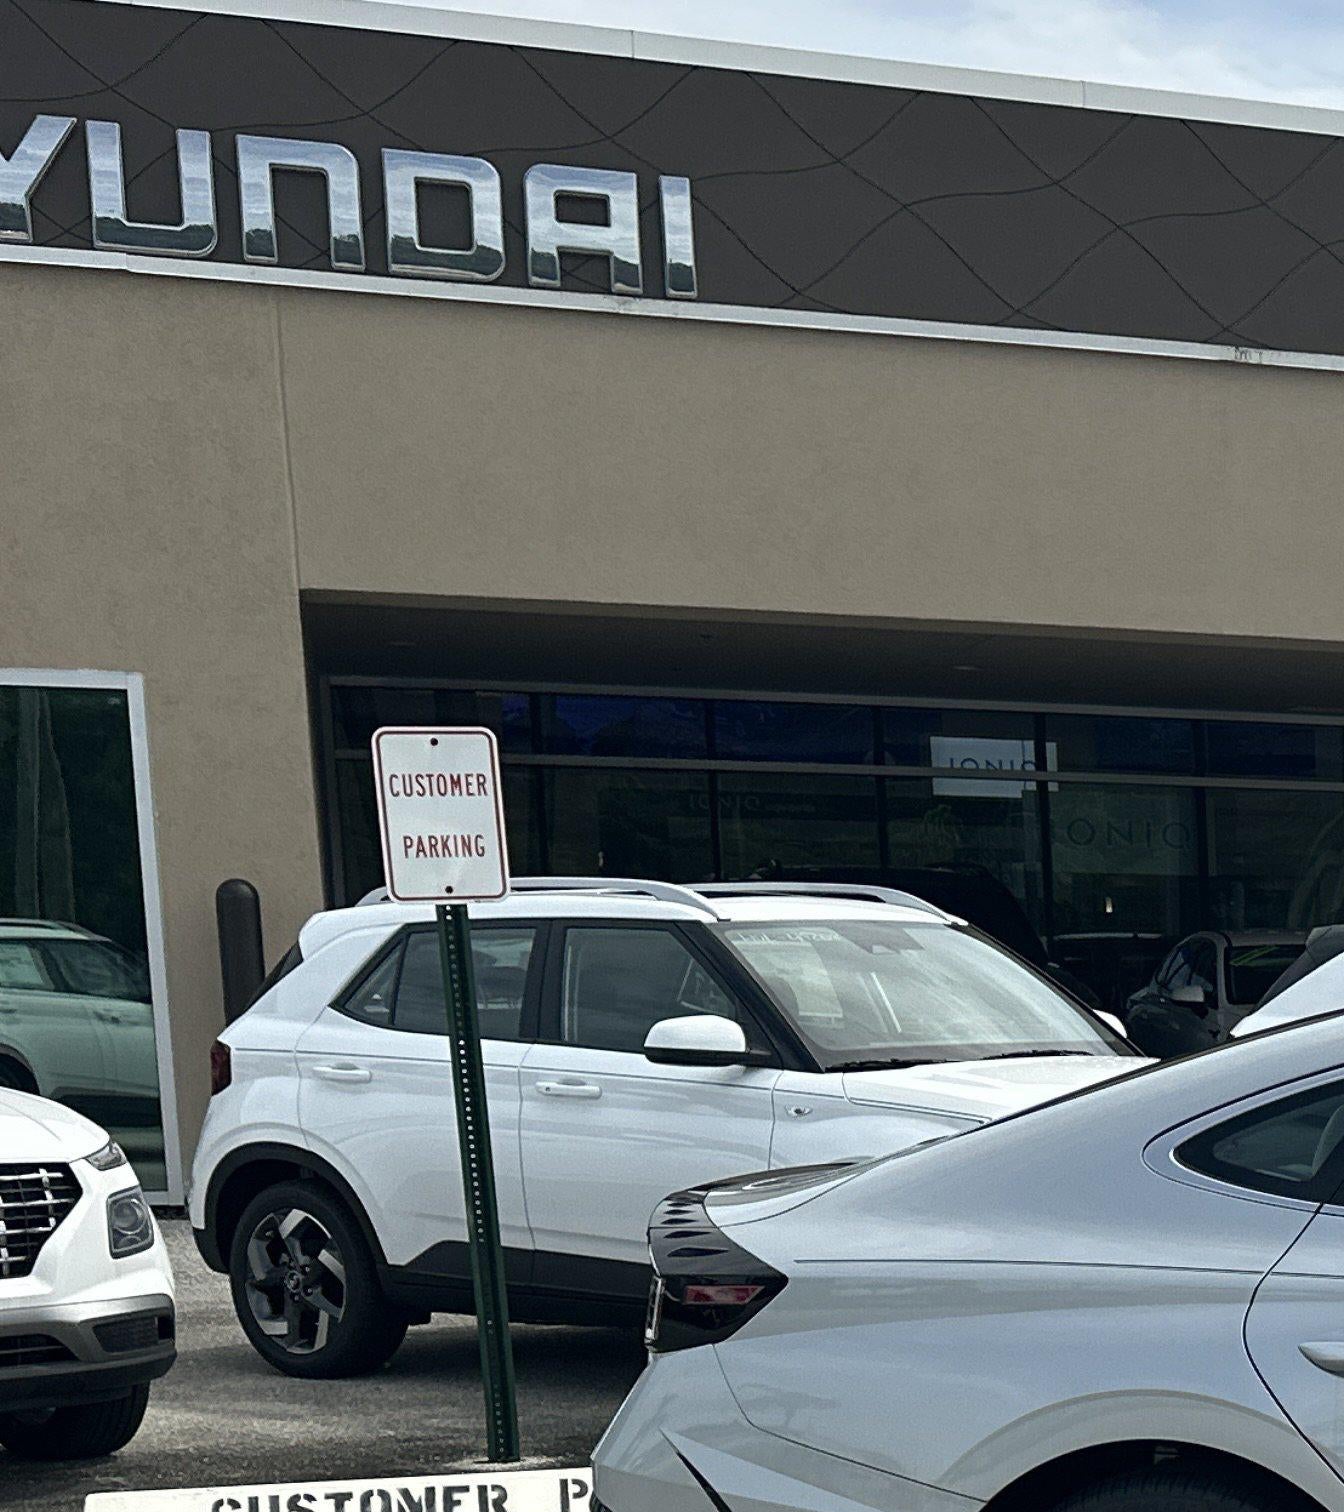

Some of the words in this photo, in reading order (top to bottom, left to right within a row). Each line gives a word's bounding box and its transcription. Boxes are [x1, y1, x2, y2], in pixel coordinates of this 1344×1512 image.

[0, 114, 697, 298] YUNDAI
[389, 773, 488, 798] CUSTOMER
[403, 834, 486, 859] PARKING
